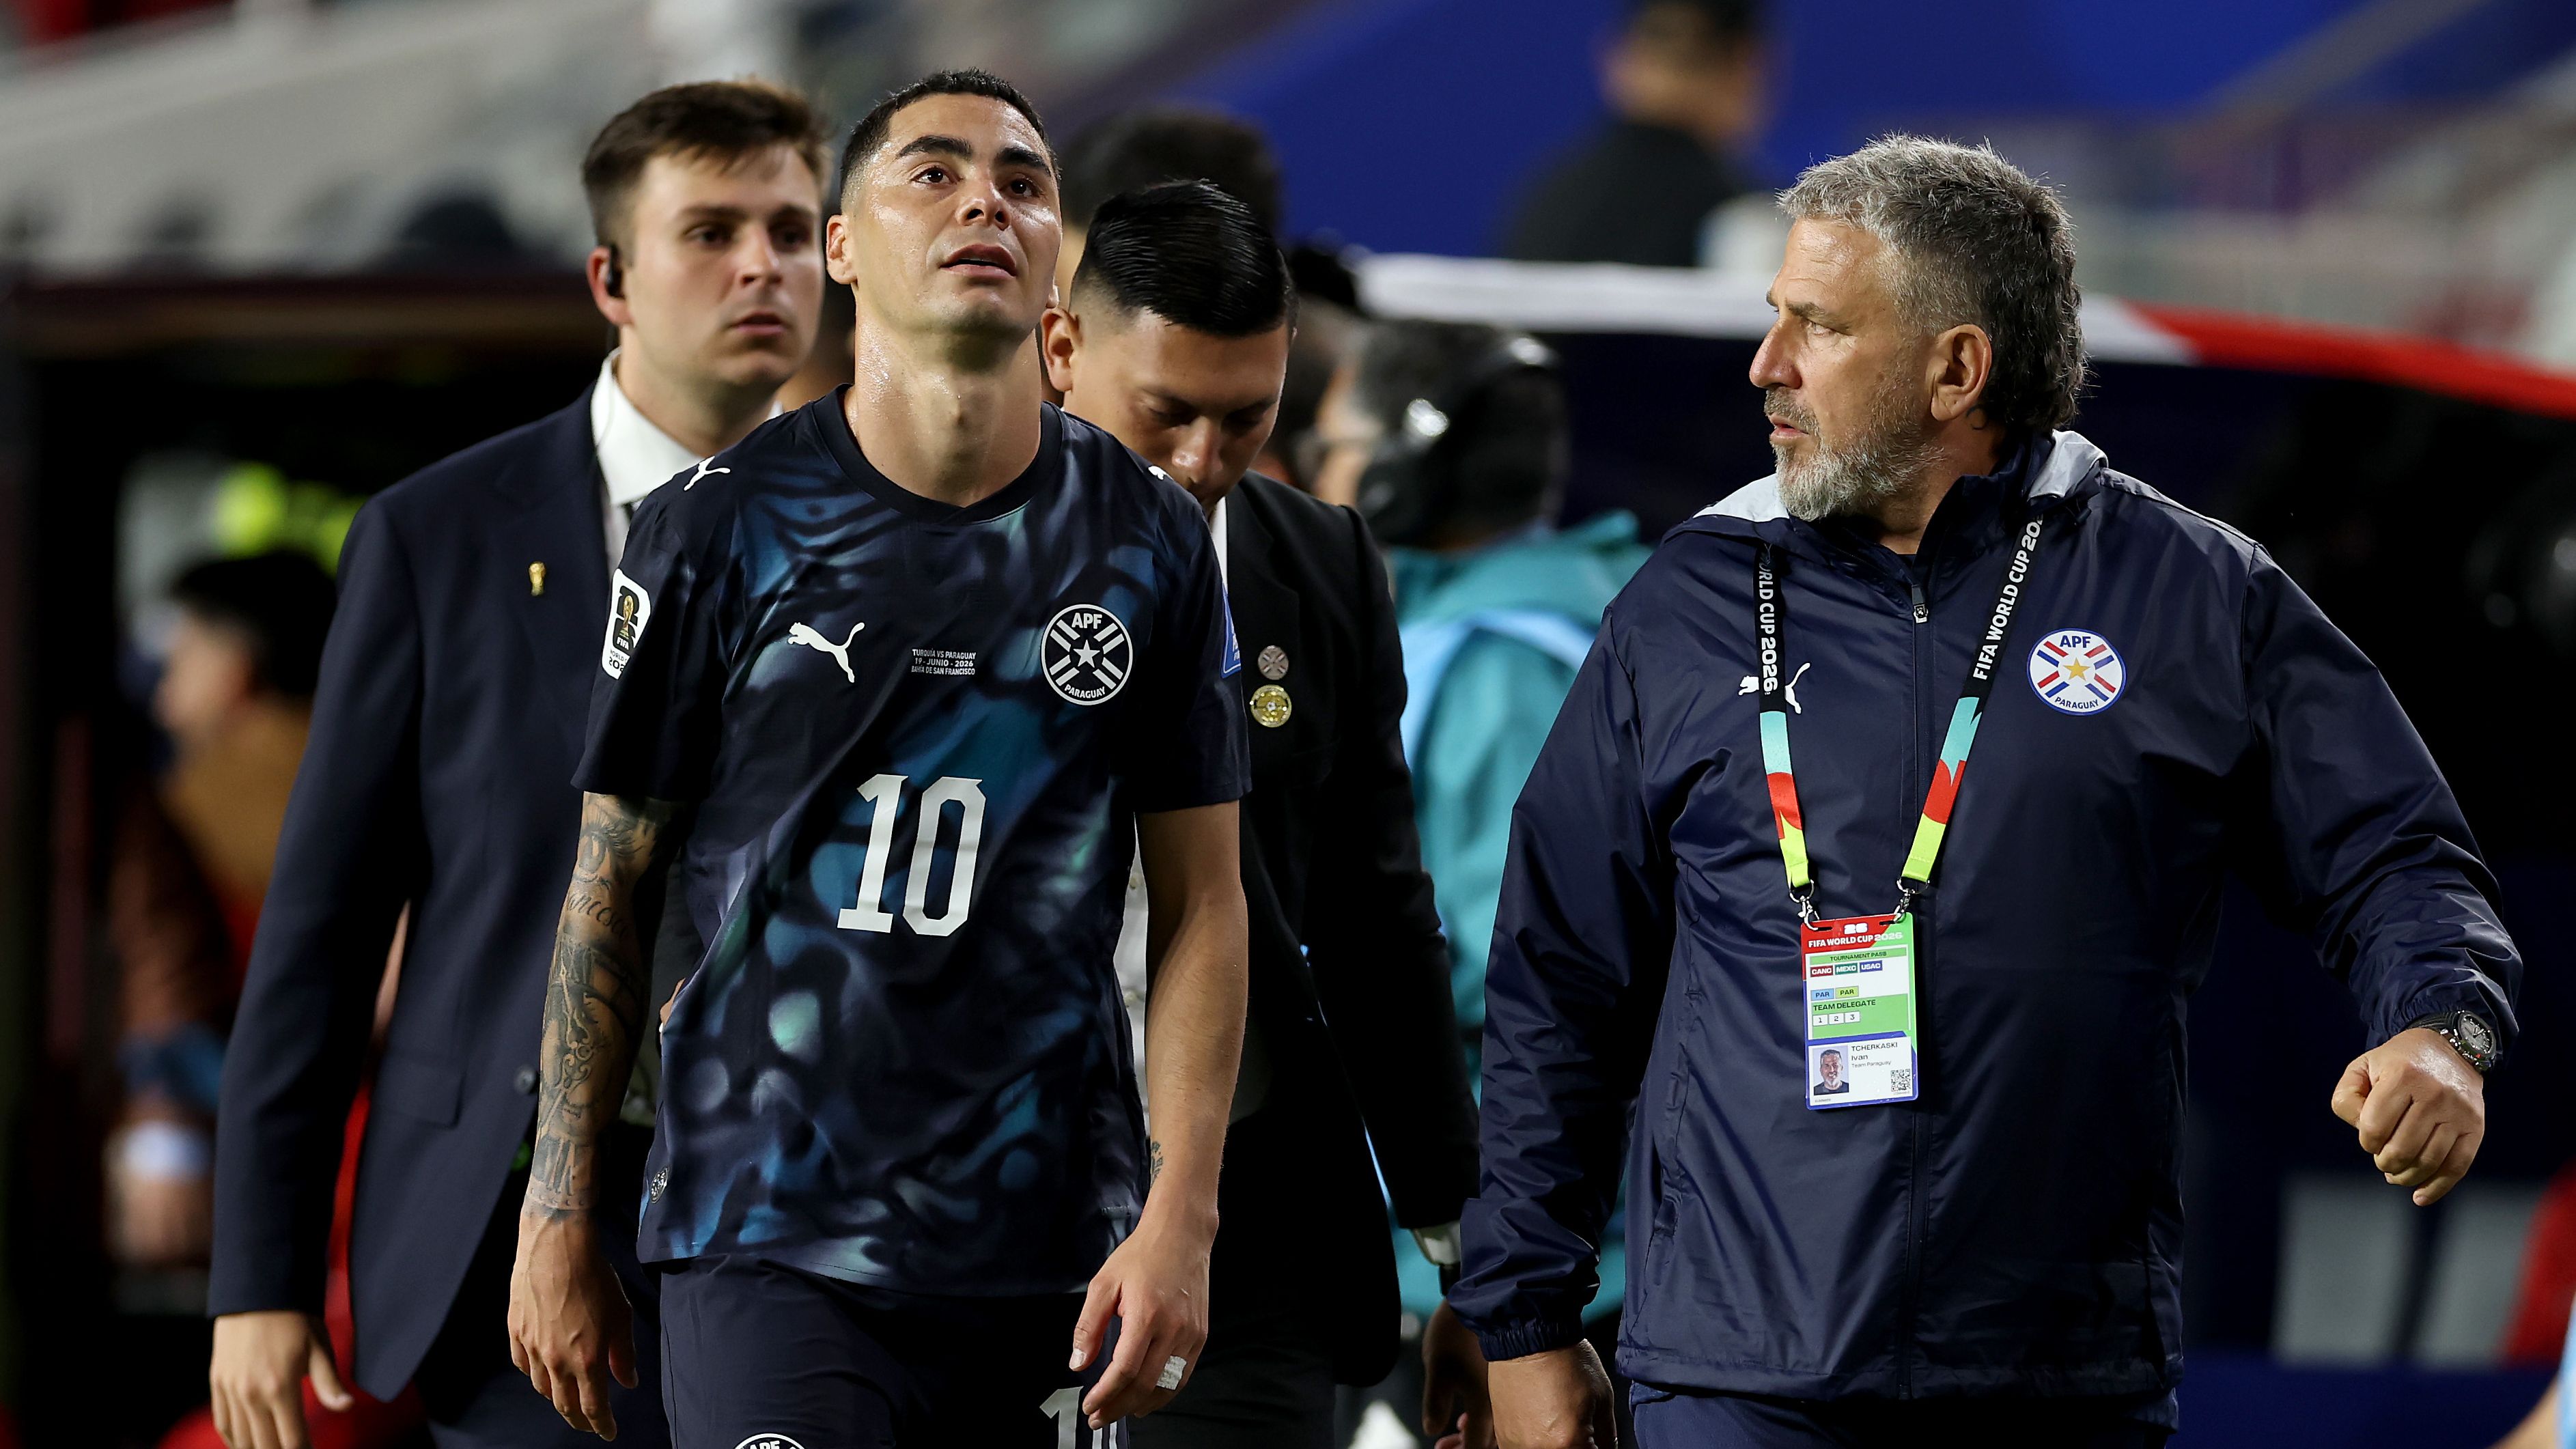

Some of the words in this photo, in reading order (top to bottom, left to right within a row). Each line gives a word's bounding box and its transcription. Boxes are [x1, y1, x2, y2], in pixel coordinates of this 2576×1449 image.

[1759, 557, 1774, 600] ORLD
[1973, 645, 1998, 680] FIFA
[1986, 584, 2019, 641] WORLD
[2008, 550, 2030, 583] CUP
[2021, 514, 2043, 552] 20
[1072, 612, 1103, 630] APF
[1759, 602, 1776, 634] CUP
[2059, 635, 2091, 648] APF
[927, 658, 949, 666] JUNIO
[945, 651, 977, 660] PARAGUAY
[1761, 637, 1778, 692] 2026
[1064, 684, 1106, 699] PARAGUAY
[2055, 697, 2099, 709] PARAGUAY
[837, 774, 987, 937] 10
[1808, 938, 1826, 948] FIFA
[1827, 936, 1856, 946] WORLD
[1857, 935, 1874, 943] CUP
[1874, 931, 1903, 942] 2026
[1830, 953, 1871, 961] TOURNAMENT
[1813, 1003, 1835, 1011] TEAM
[1836, 1000, 1876, 1009] DELEGATE
[1851, 1042, 1898, 1052] TCHERKASKI
